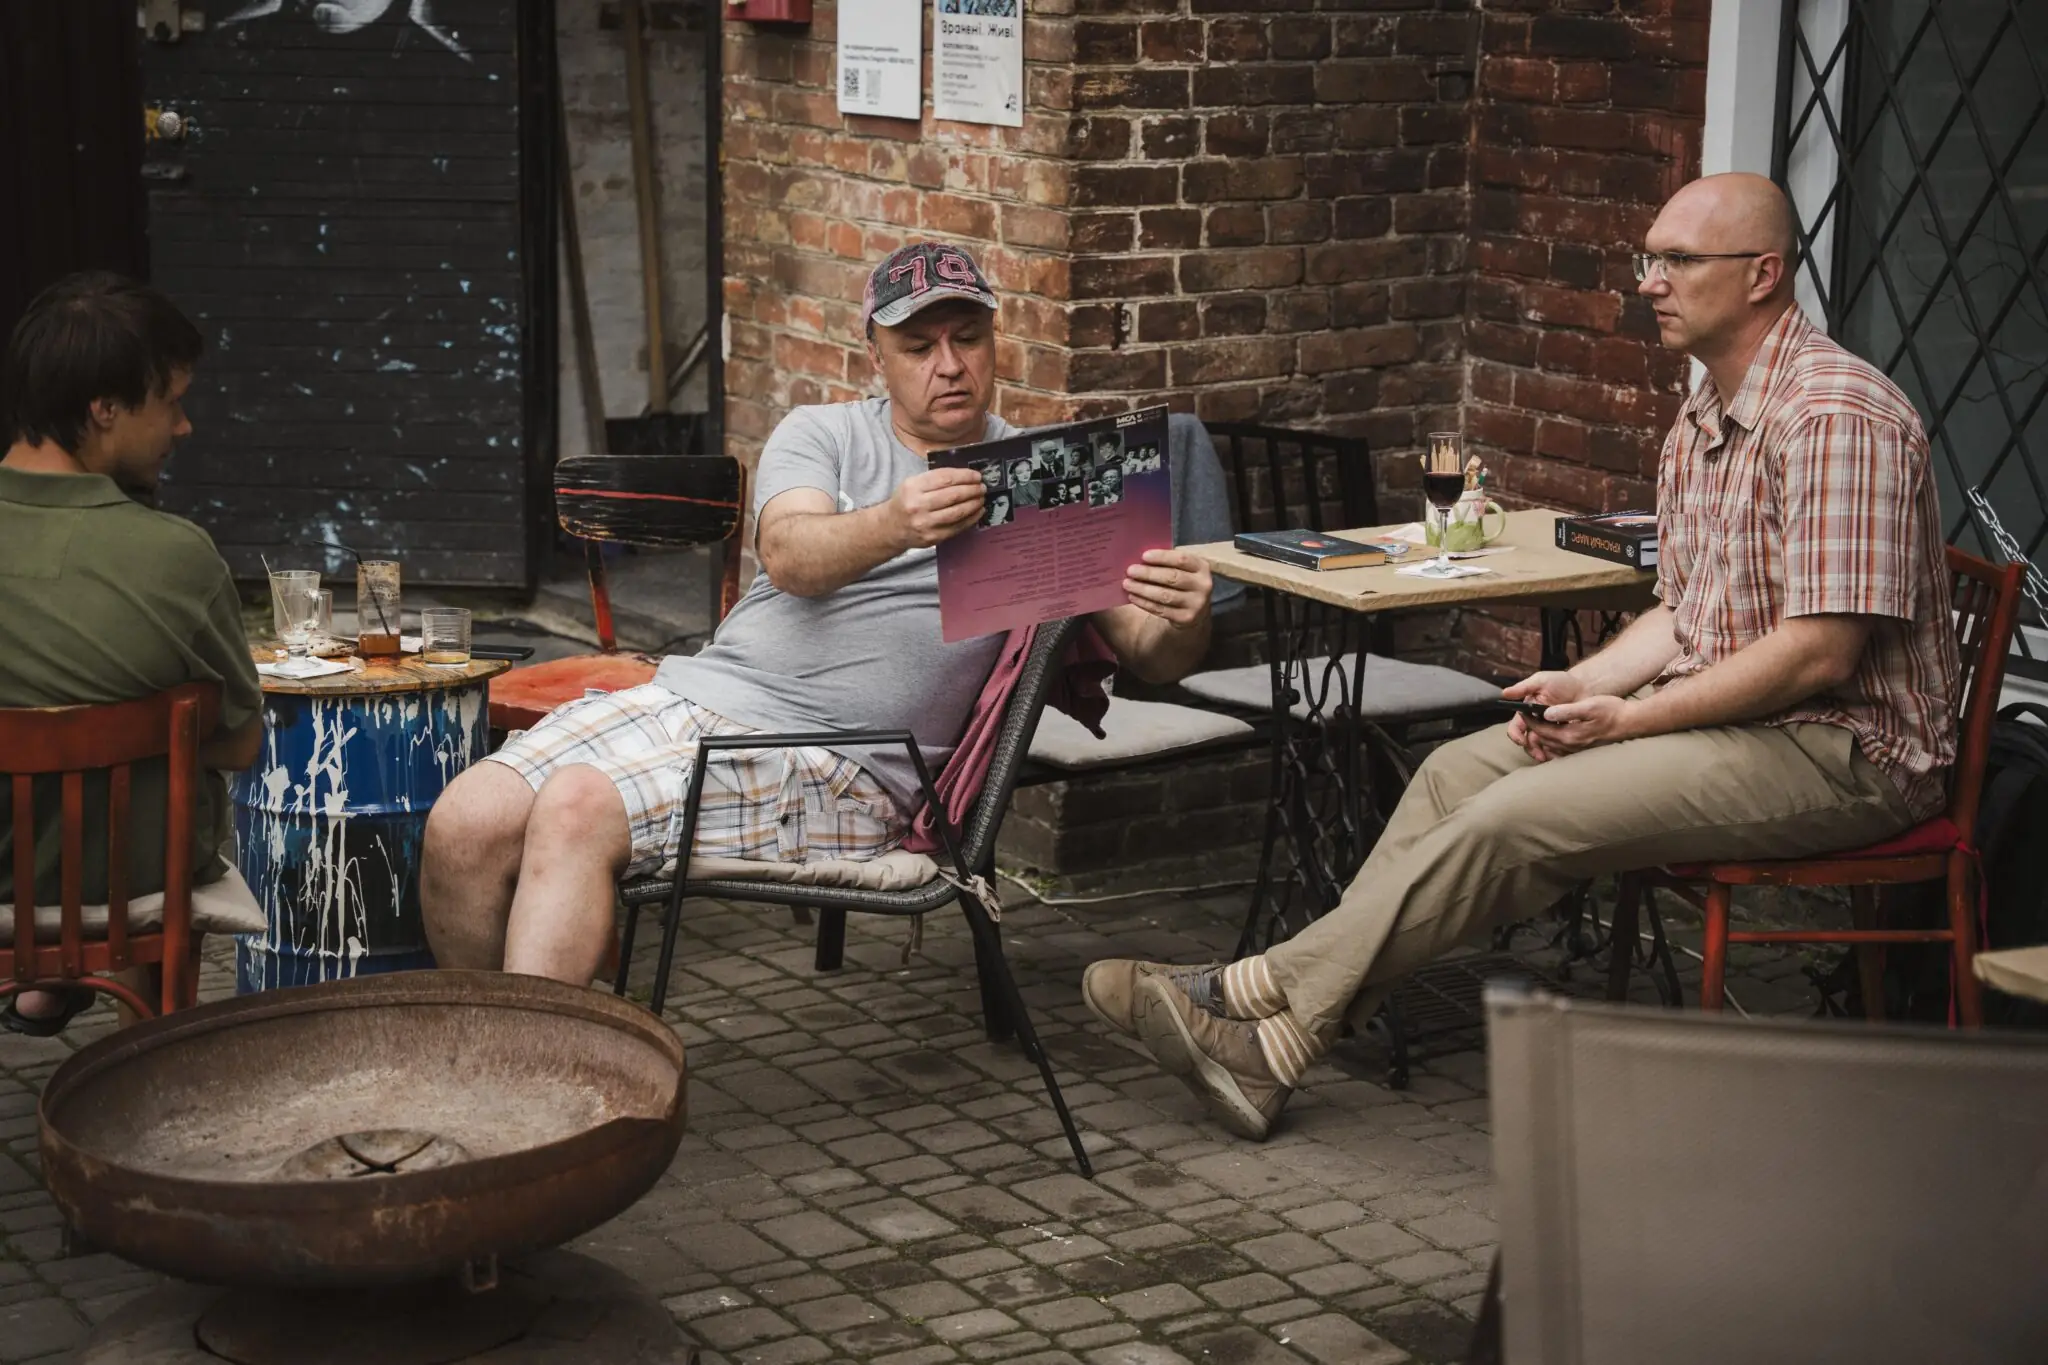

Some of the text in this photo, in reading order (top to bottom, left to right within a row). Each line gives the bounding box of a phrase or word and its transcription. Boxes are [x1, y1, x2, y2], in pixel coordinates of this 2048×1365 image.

[1116, 414, 1136, 425] MCA
[1571, 531, 1590, 546] МАРС
[1590, 536, 1621, 553] КРАСНЫЙ
